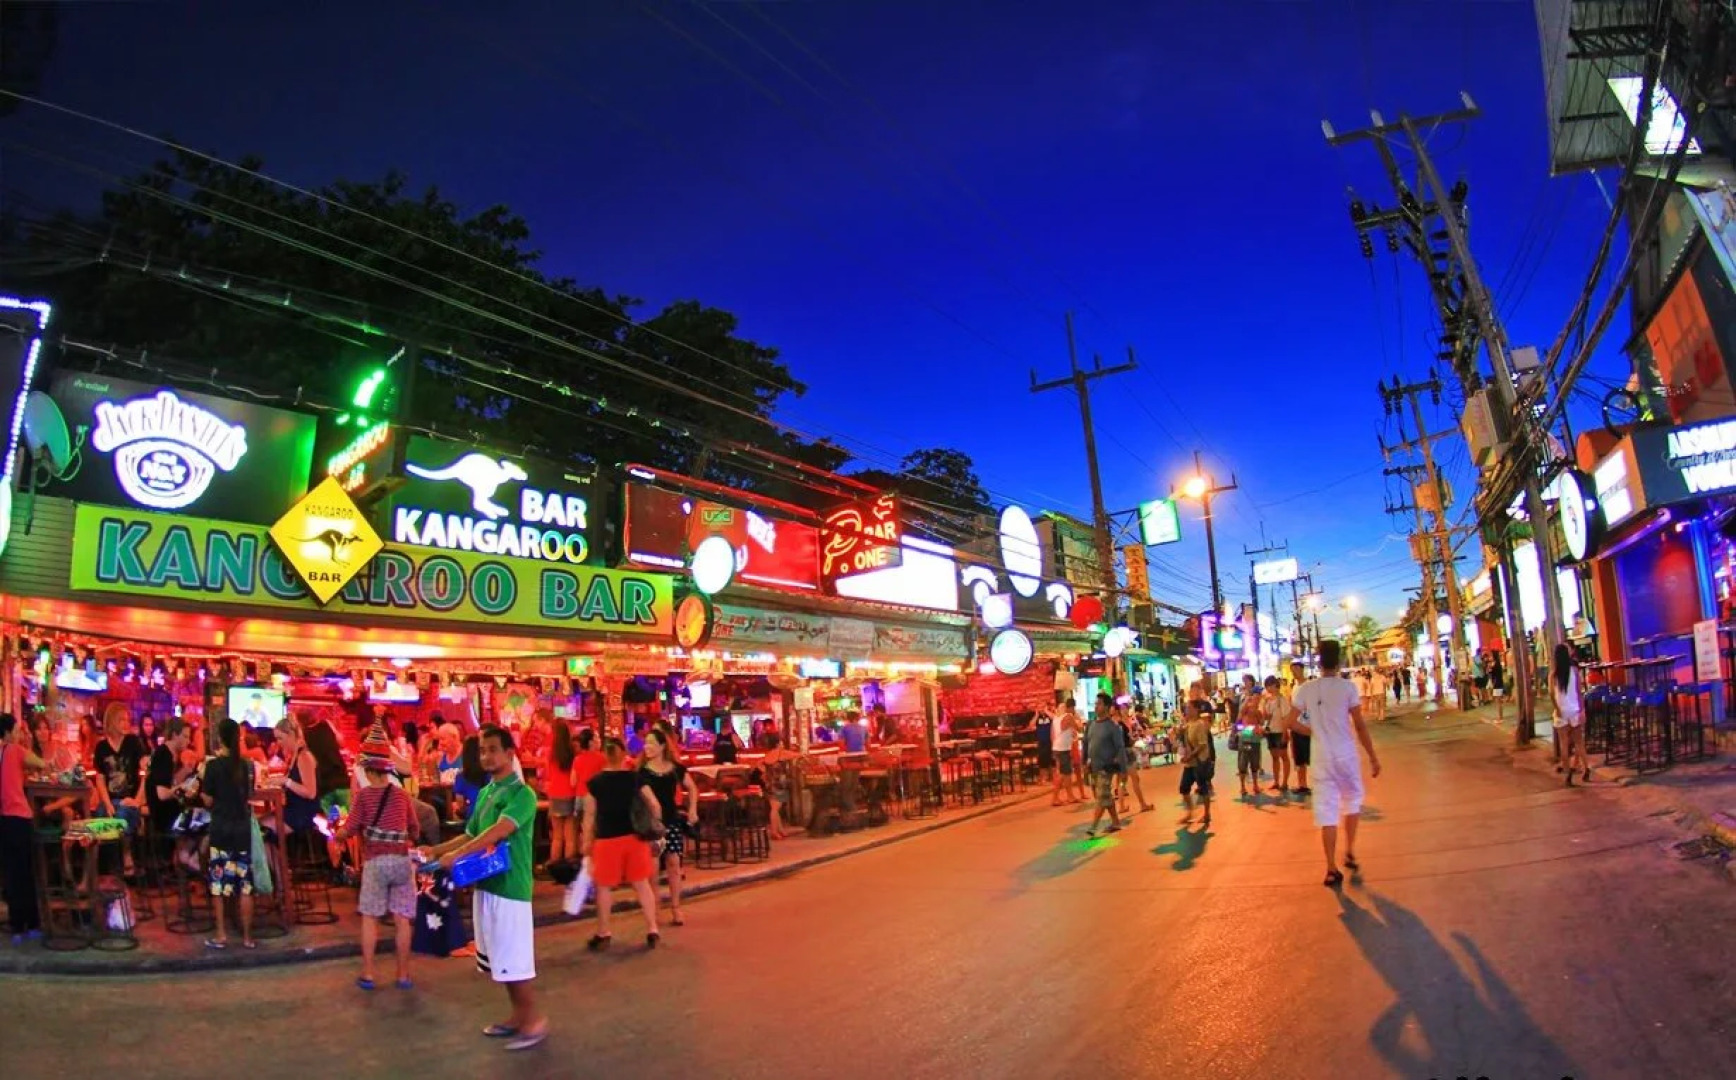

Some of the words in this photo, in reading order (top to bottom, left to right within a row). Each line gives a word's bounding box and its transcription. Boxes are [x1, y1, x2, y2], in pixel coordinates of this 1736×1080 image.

[304, 503, 354, 519] KANGAROO
[521, 487, 588, 529] BAR
[394, 506, 588, 564] KANGAROO
[98, 520, 518, 616] KANGROO
[540, 569, 660, 626] BAR
[854, 547, 889, 570] ONE
[307, 571, 341, 583] BAR
